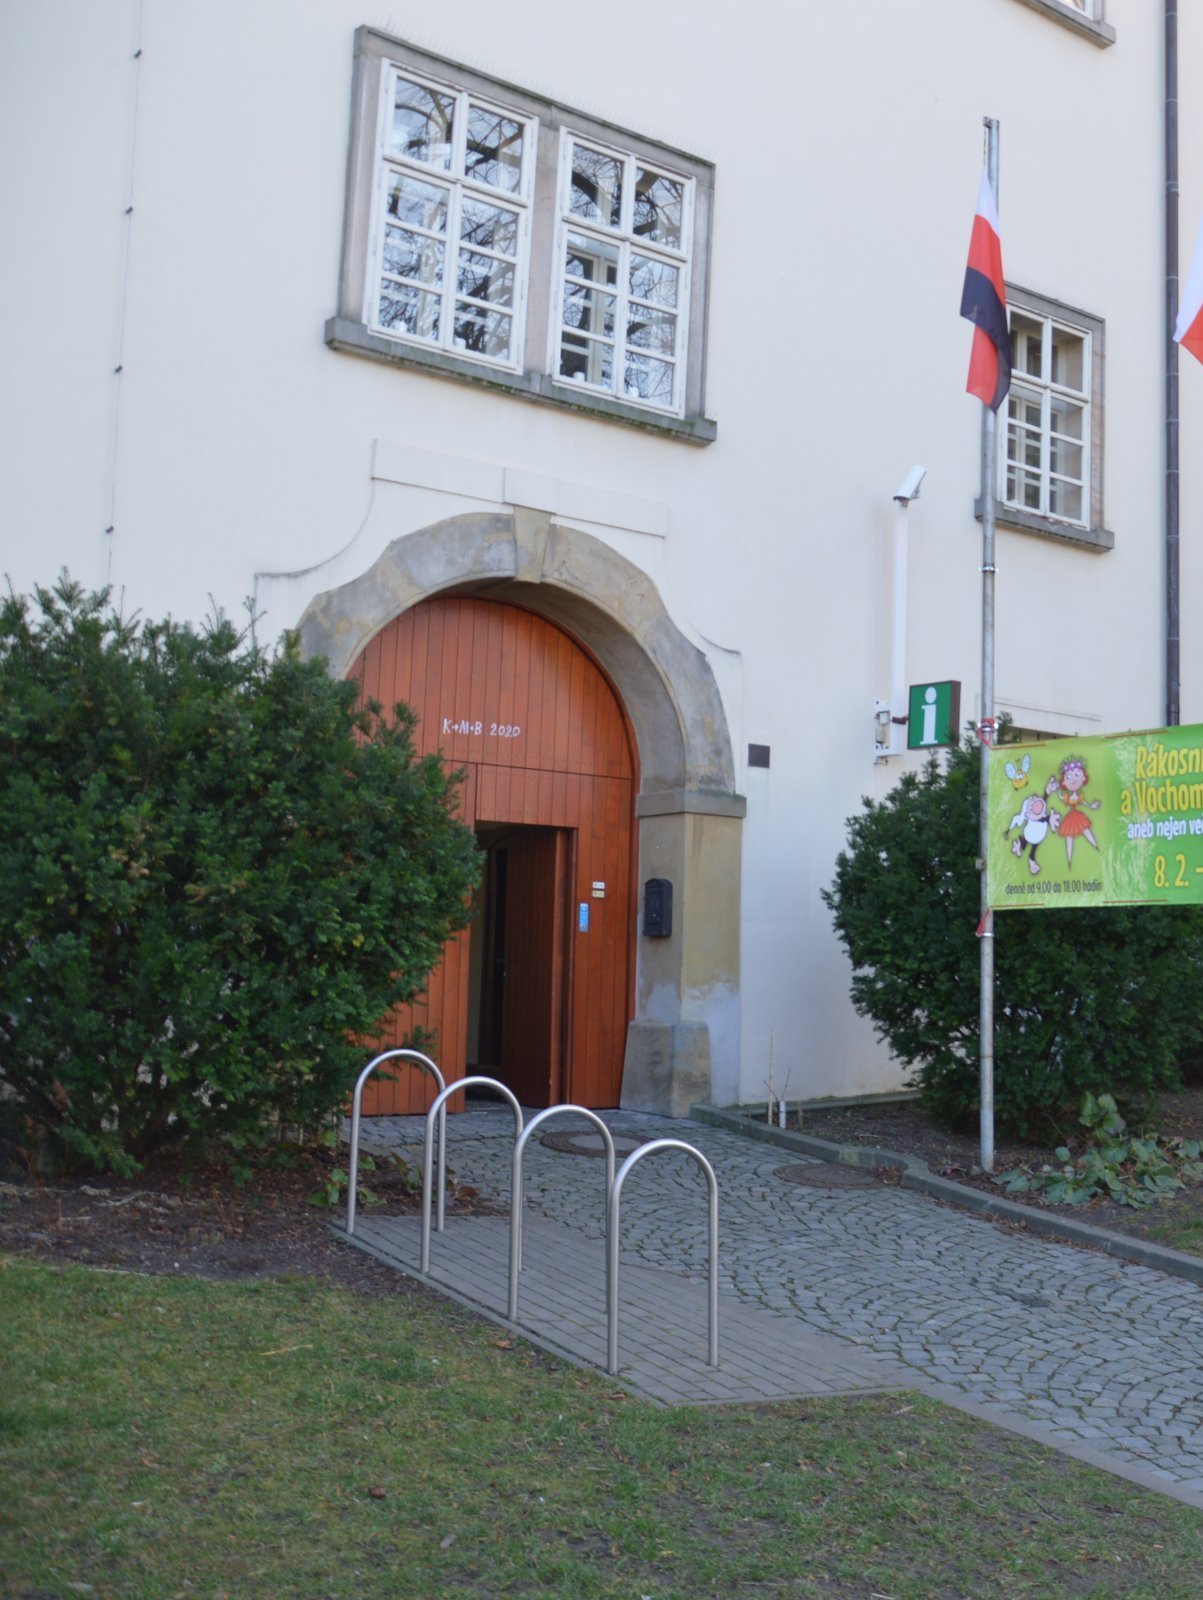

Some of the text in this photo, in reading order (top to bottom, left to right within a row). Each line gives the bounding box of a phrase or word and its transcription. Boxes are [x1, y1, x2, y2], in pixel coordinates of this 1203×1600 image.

[490, 722, 520, 738] 2020
[1121, 789, 1132, 815] a
[1127, 818, 1154, 839] aneb
[1156, 816, 1186, 840] nejen
[1154, 855, 1169, 887] 8.
[1174, 853, 1189, 887] 2.
[1027, 881, 1035, 894] od
[1053, 881, 1061, 893] do
